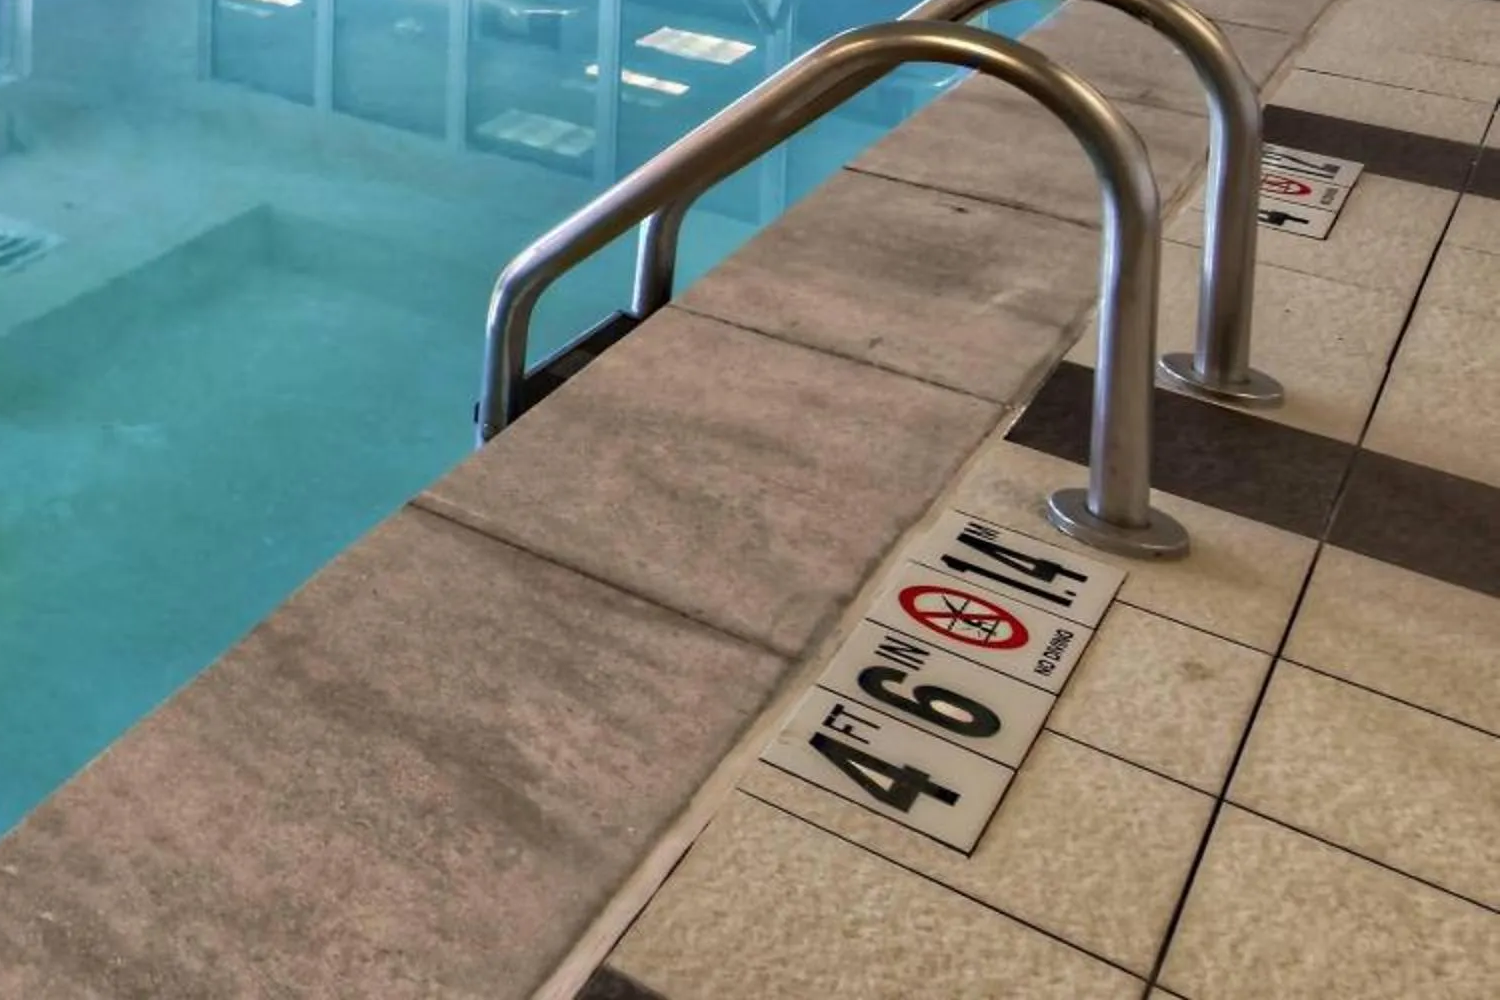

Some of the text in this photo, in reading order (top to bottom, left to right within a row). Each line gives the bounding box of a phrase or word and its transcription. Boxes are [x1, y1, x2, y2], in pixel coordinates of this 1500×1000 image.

[874, 635, 931, 671] IN
[823, 703, 881, 746] FT
[858, 666, 1001, 738] 6
[809, 731, 961, 814] 4
